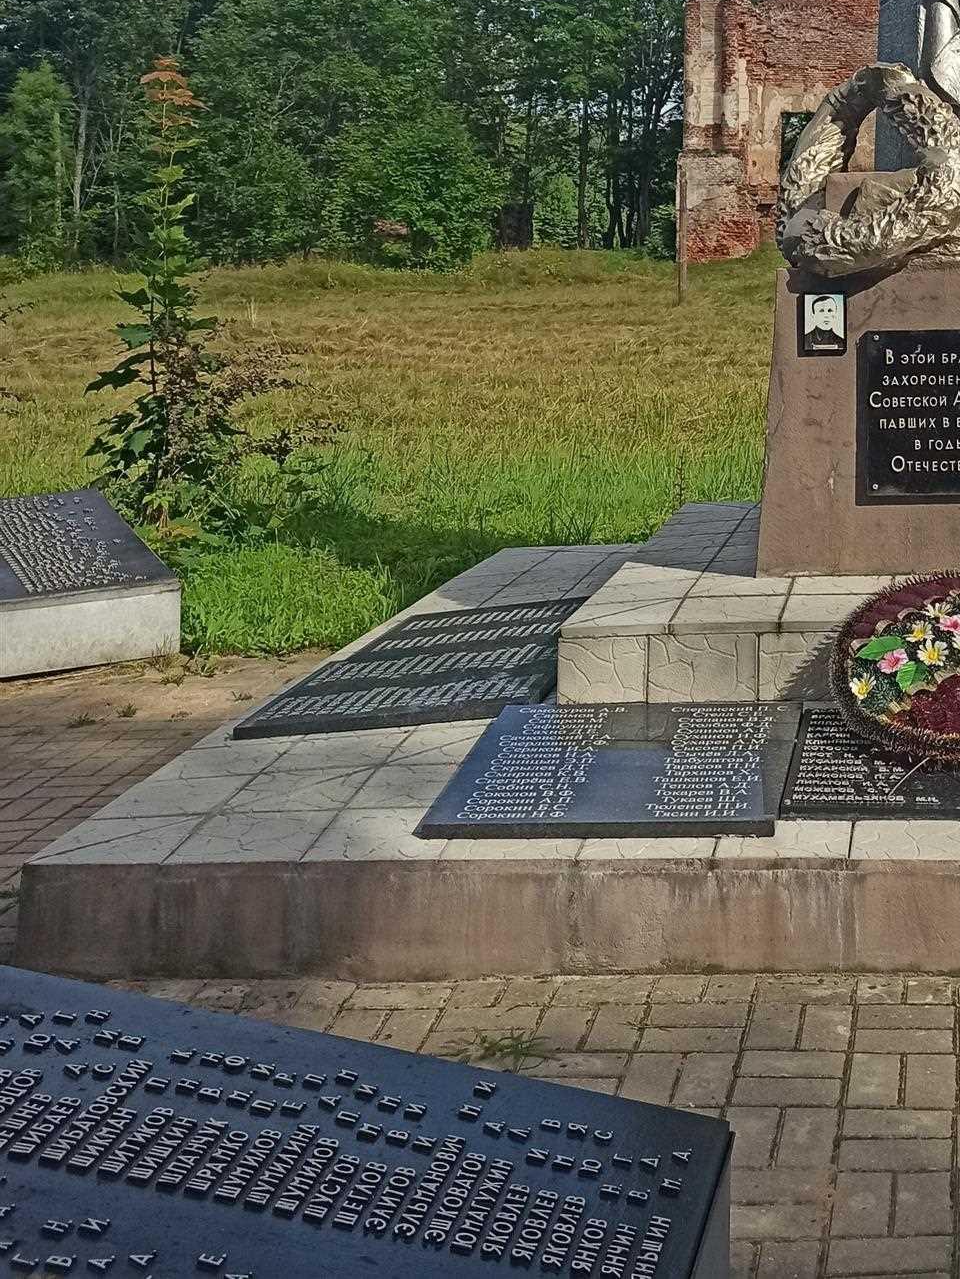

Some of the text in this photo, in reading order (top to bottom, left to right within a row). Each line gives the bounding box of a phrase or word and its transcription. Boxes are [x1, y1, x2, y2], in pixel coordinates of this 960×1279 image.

[886, 349, 894, 365] В
[901, 352, 935, 365] ЭТОЙ
[869, 391, 947, 409] СОВЕТСКОЙ
[879, 417, 936, 430] ПАВШИХ
[942, 417, 950, 429] В
[914, 439, 922, 451] В
[9, 1096, 82, 1155] ШИБАЕВ
[68, 1106, 138, 1168] ШИКМАН
[99, 1105, 175, 1174] ШИТИКОВ
[127, 1116, 198, 1179] ШИШКИН
[157, 1117, 229, 1184] ШПАНЧУК
[186, 1129, 249, 1192] ШРАМКО
[215, 1128, 284, 1200] ШУМИЛОВ
[275, 1136, 340, 1212] ШУМИЛОВ
[304, 1152, 361, 1220] ШУСТОВ
[394, 1134, 466, 1238] ЭЛЬМАНОВИЧ
[365, 1165, 417, 1231] ЭЛИТОВ
[424, 1151, 488, 1244] ЭШКОВАТОВ
[452, 1158, 514, 1249] ЮМАГУЖИН
[481, 1183, 531, 1256] ЯКОВЛЕВ
[512, 1189, 559, 1261] ЯКОВЛЕВ
[542, 1195, 586, 1268] ЯКОВЛЕВ
[571, 1217, 608, 1273] ЯНКОВ
[601, 1222, 638, 1279] ЯНЧИН
